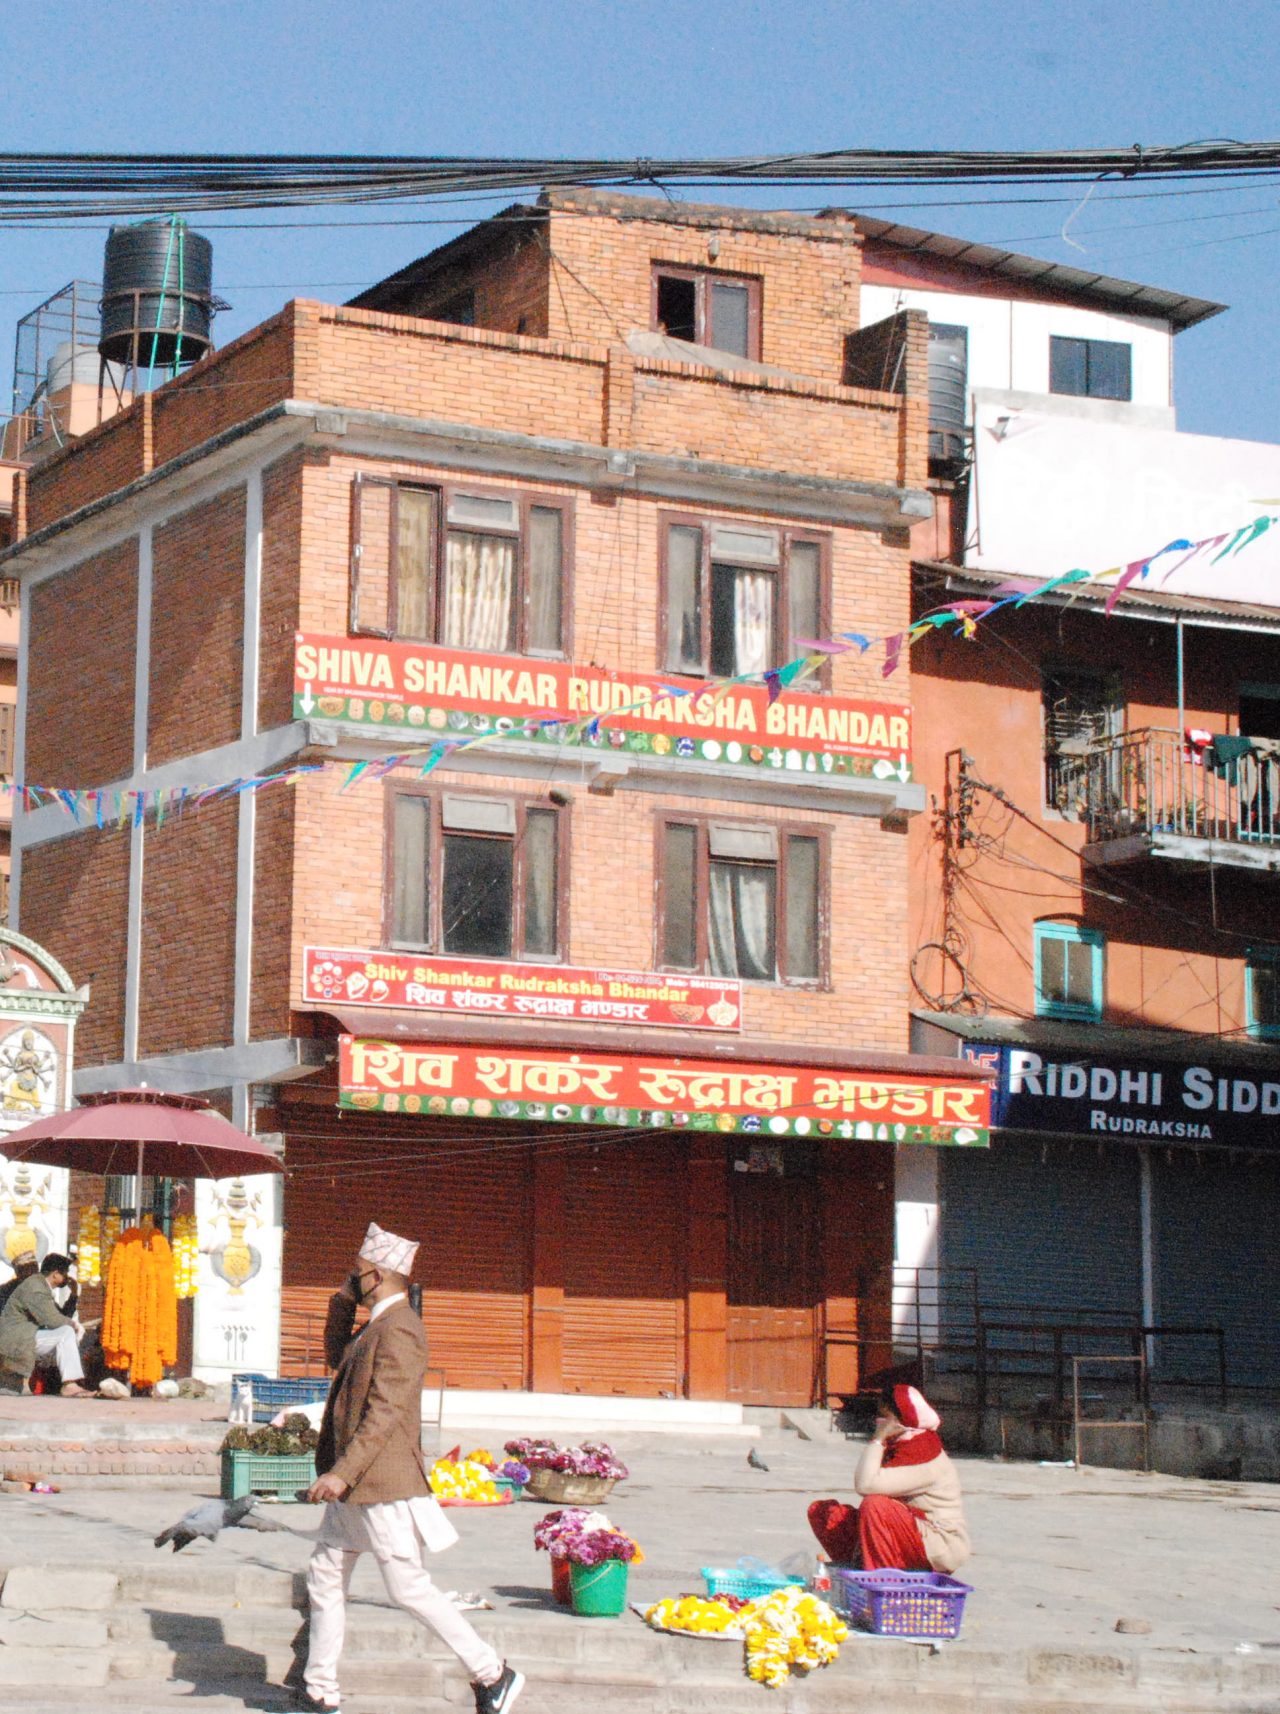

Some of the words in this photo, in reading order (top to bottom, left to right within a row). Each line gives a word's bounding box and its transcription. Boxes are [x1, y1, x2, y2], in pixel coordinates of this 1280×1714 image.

[295, 645, 394, 689] SHIVA
[404, 657, 557, 708] SHANKAR
[568, 677, 756, 732] RUDRAKSHA
[766, 703, 909, 749] BHANDAR
[365, 963, 407, 981] Shiv
[413, 967, 495, 988] Shankar
[500, 974, 603, 996] Rudraksha
[609, 982, 689, 1003] Bhandar
[405, 983, 447, 1005] शिव
[350, 1042, 458, 1088] शिव
[813, 1077, 984, 1122] भण्डार
[1009, 1049, 1162, 1105] RIDDHI
[1091, 1110, 1212, 1139] RUDRAKSHA
